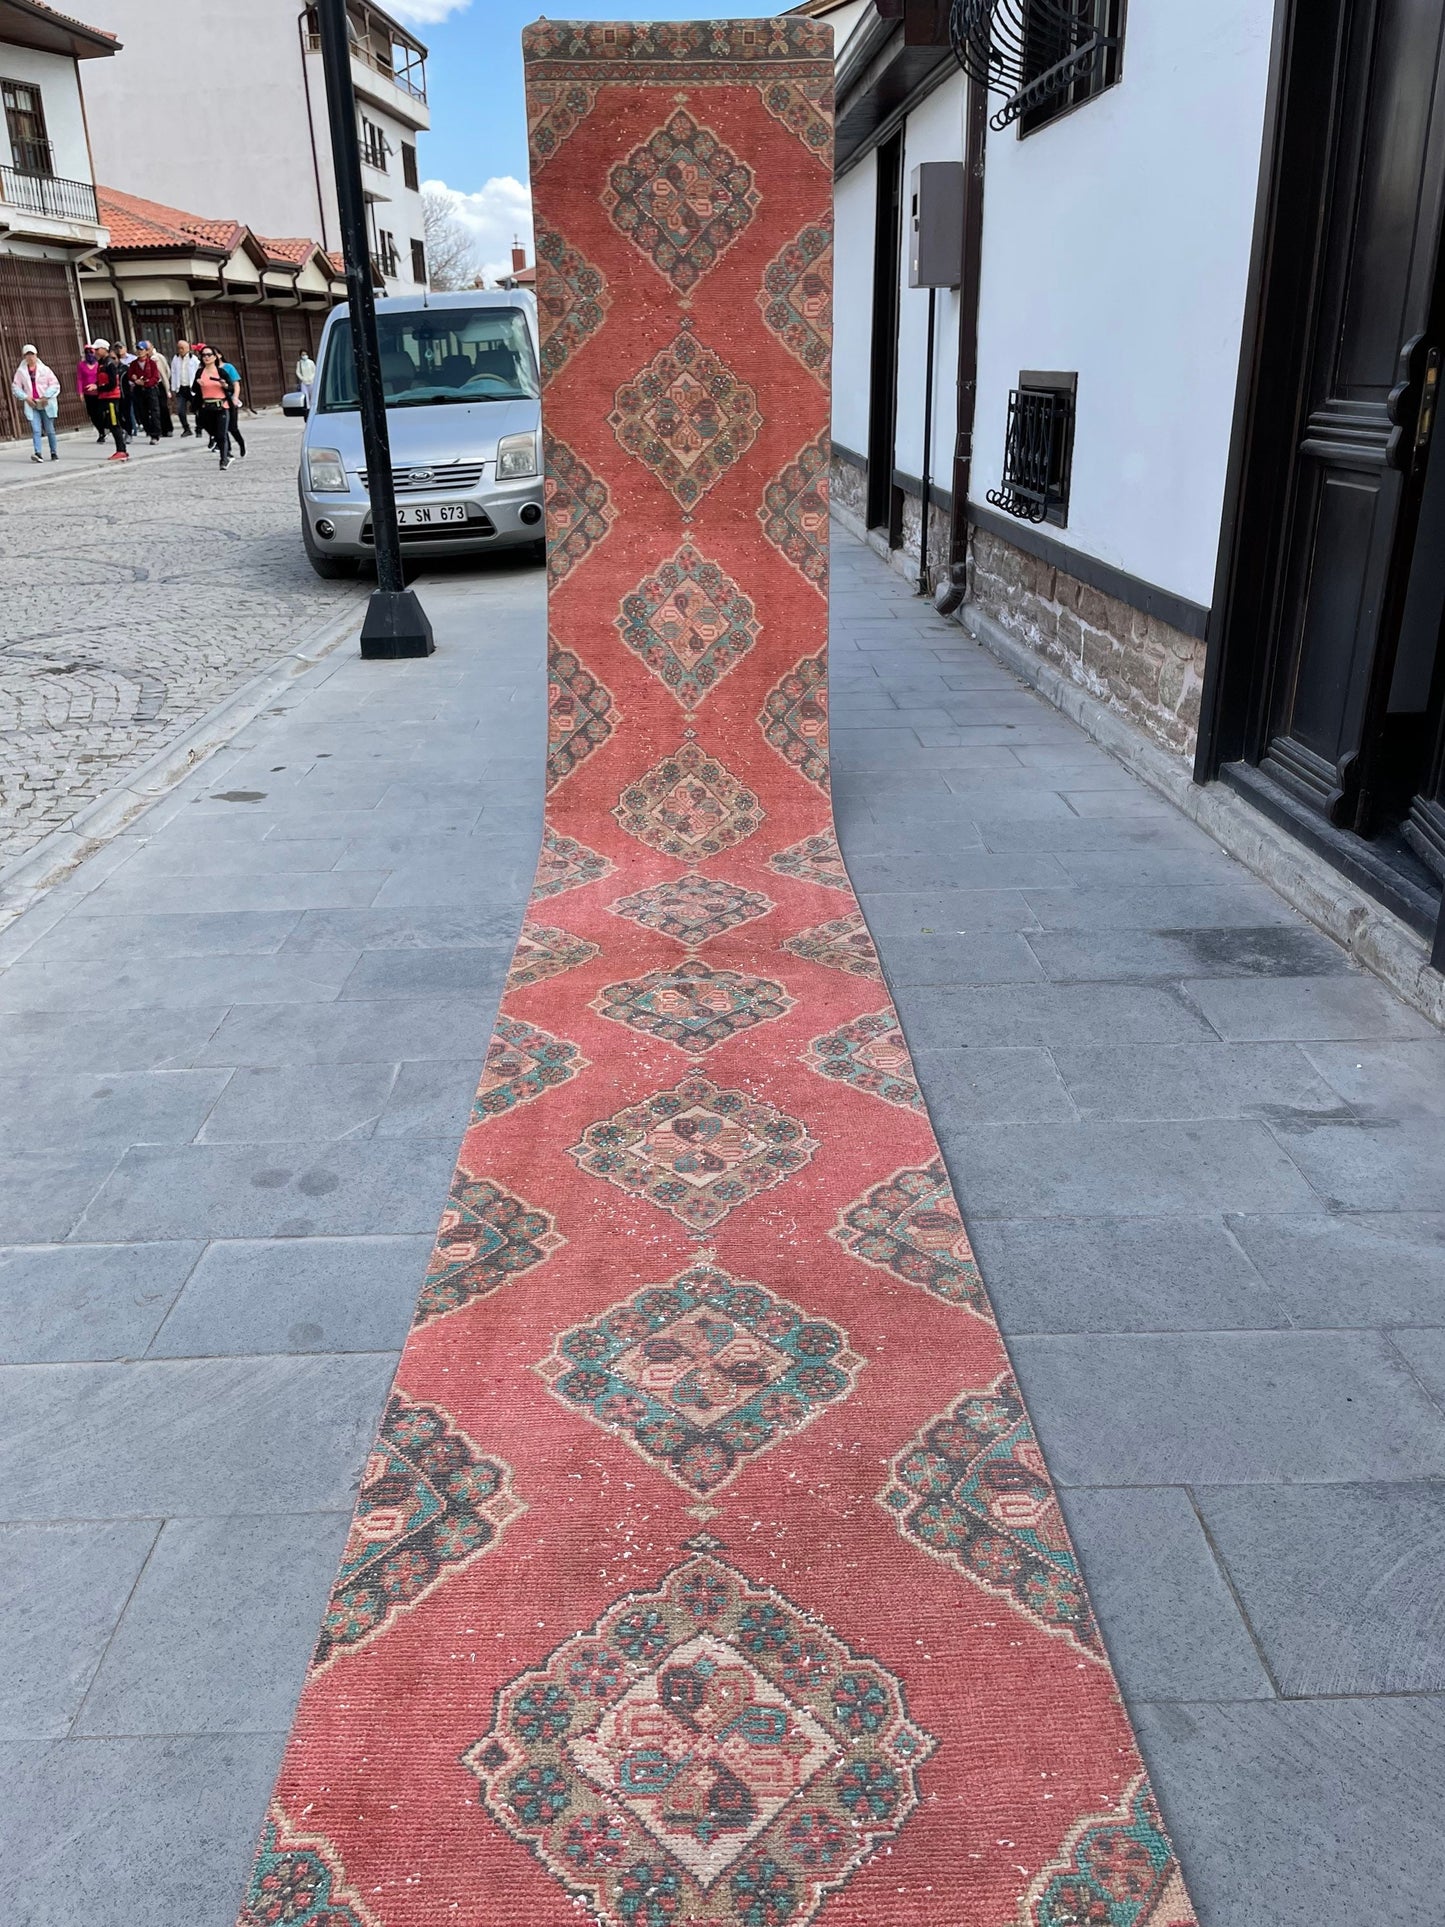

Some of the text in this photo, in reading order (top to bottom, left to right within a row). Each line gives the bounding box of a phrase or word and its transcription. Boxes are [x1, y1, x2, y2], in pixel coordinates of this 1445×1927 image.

[398, 506, 464, 523] 2 SN 673
